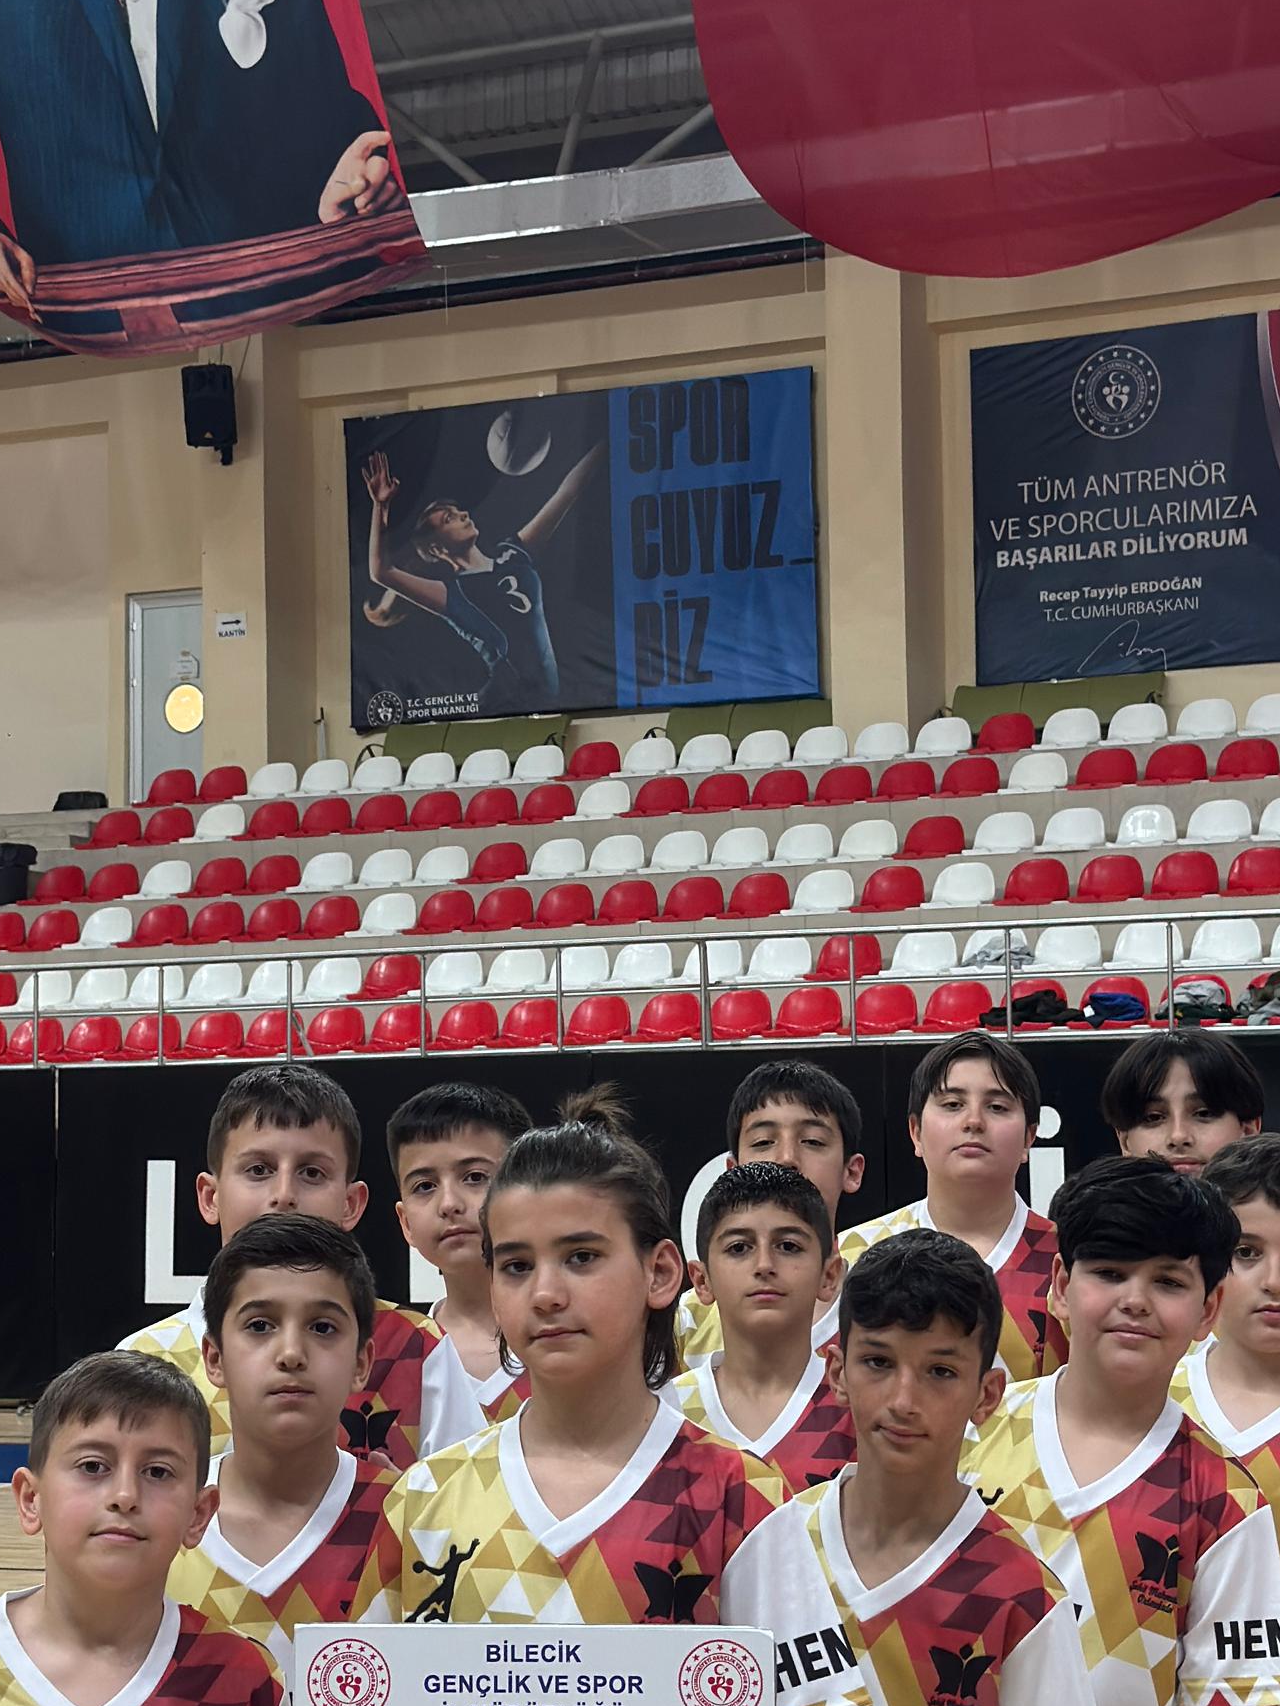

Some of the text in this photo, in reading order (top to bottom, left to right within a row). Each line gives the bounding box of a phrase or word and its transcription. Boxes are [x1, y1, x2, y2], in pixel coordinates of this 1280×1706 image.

[626, 375, 751, 474] SPOR
[1017, 459, 1227, 505] TÜM ANTRENÖR
[629, 480, 784, 580] CUYUZ
[989, 493, 1258, 543] VE SPORCULARIMIZA
[995, 525, 1249, 571] BAŞARILAR DİLİYORUM
[497, 575, 532, 615] 3
[1039, 575, 1203, 606] Recep Tayyip ERDOĞAN
[1043, 596, 1200, 623] T.C. CUMHURBAŞKANI
[633, 589, 714, 689] BİZ
[407, 703, 480, 719] SPOR BAKANLIĞI
[425, 694, 465, 706] GENÇLİK
[467, 693, 479, 702] VE
[485, 1639, 582, 1663] BİLECİK
[423, 1672, 644, 1699] GENÇLİK VE SPOR
